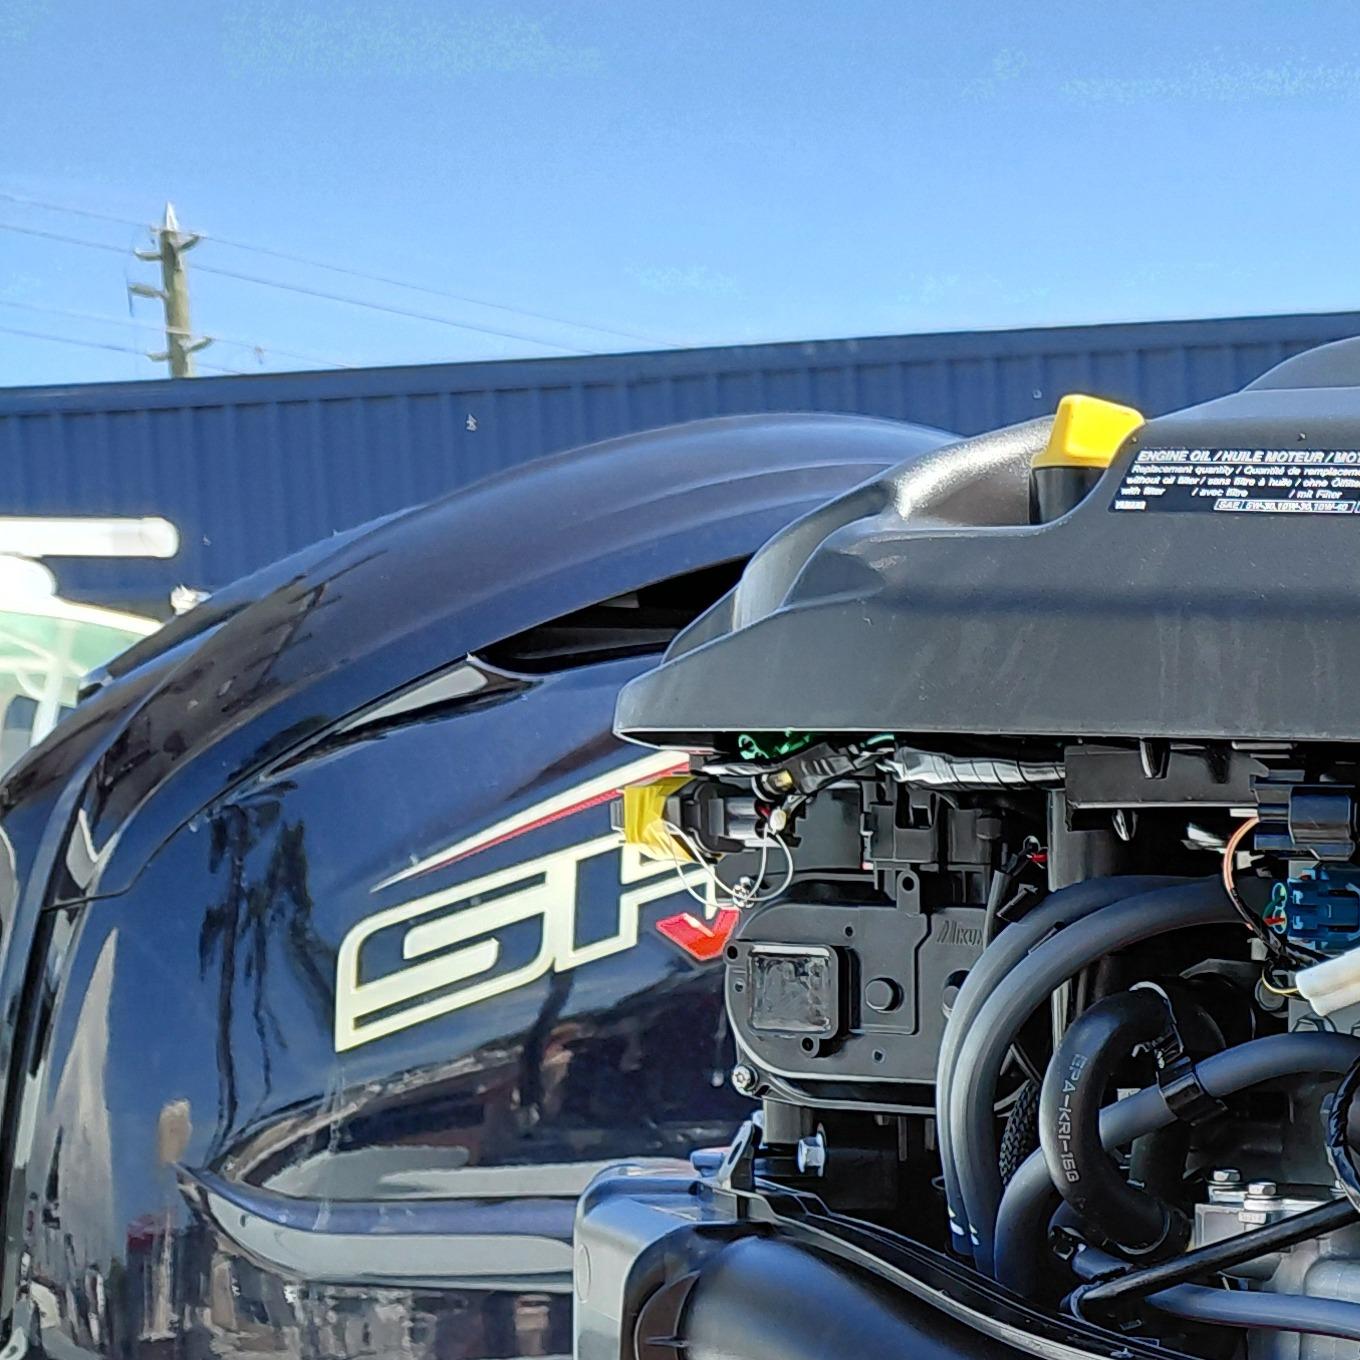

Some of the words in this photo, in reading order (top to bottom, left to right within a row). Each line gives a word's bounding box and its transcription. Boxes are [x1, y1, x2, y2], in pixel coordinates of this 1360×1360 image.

[1138, 451, 1188, 462] ENGINE
[1190, 452, 1211, 462] OIL
[1222, 452, 1262, 462] HUILE
[1265, 452, 1325, 463] MOTEUR
[1131, 465, 1194, 475] Replacement
[1195, 466, 1234, 476] quantity
[1126, 476, 1161, 485] without
[1208, 478, 1231, 486] sans
[1268, 478, 1292, 487] huile
[1303, 479, 1328, 487] ohne
[1121, 487, 1141, 495] with
[1200, 489, 1222, 497] avec
[1218, 501, 1240, 509] SAE
[1057, 1053, 1088, 1183] EPA-KRI-15G
